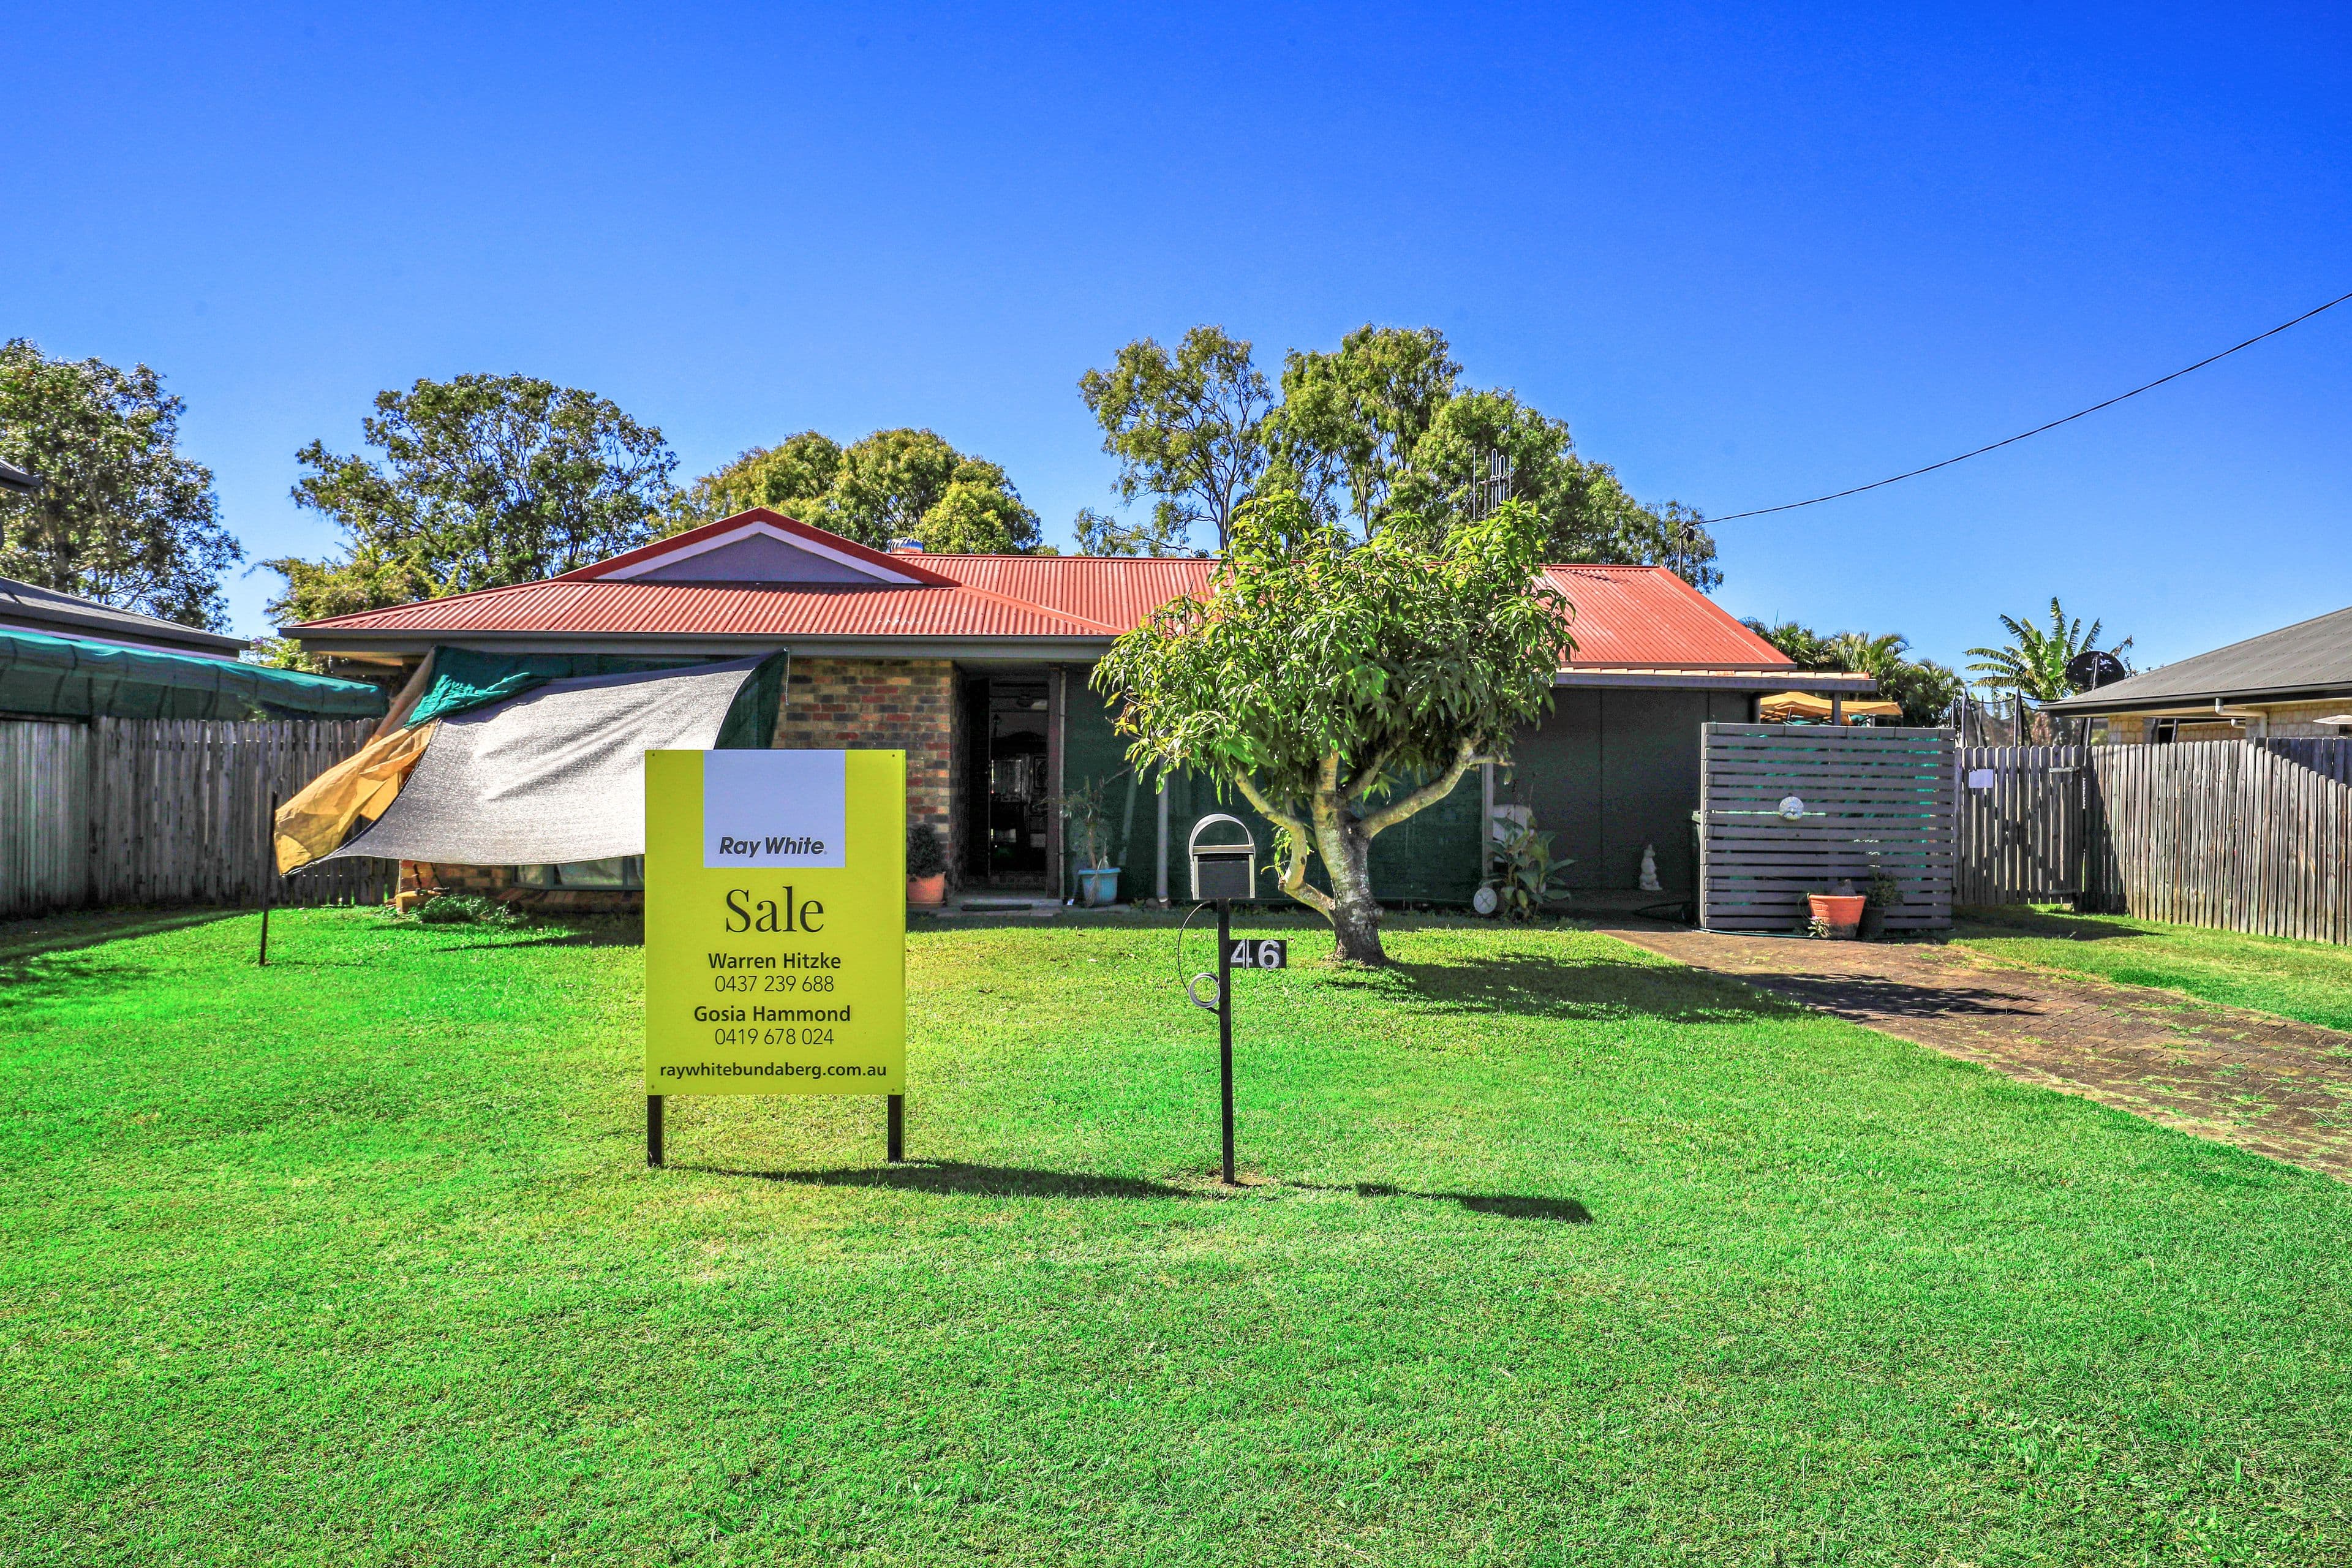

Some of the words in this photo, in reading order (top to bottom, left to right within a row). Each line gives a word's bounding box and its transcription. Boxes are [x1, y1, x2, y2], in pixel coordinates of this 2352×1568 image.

[719, 837, 762, 858] Ray
[765, 837, 824, 854] White
[726, 885, 824, 933] Sale
[707, 952, 776, 969] Warren
[783, 951, 842, 969] Hitzke
[1231, 939, 1280, 969] 46
[715, 975, 758, 992] 0437
[764, 975, 796, 992] 239
[802, 975, 834, 992] 688
[694, 1005, 746, 1022] Gosia
[753, 1005, 851, 1022] Hammond
[715, 1028, 758, 1045] 0419
[764, 1028, 796, 1045] 678
[802, 1028, 834, 1045] 024
[660, 1061, 886, 1080] raywhitebundaberg.com.au
